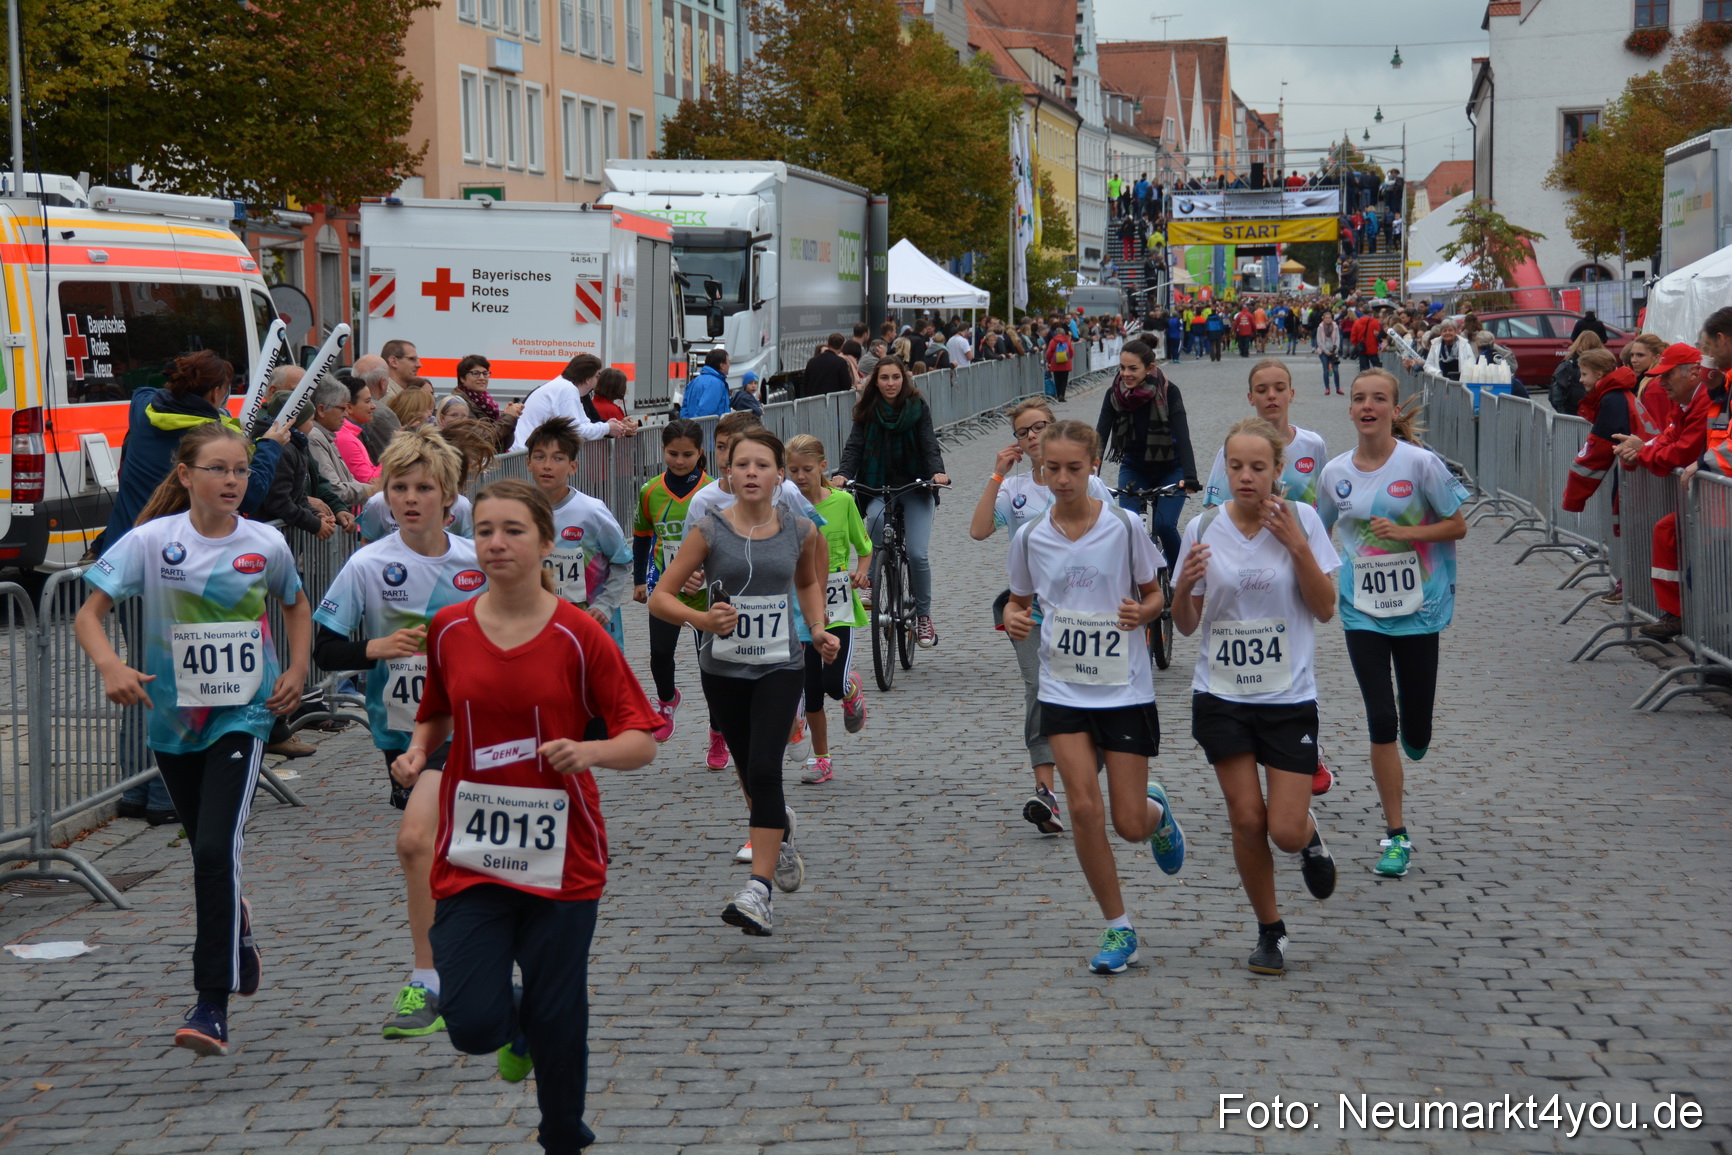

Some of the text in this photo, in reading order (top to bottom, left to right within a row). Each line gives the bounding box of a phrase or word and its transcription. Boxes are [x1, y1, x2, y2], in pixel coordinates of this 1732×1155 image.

[637, 210, 707, 226] OCK
[1223, 225, 1280, 239] START
[838, 231, 861, 280] BOCK
[472, 269, 552, 282] Bayerisches
[472, 285, 509, 297] Rotes
[893, 294, 945, 305] Laufsport
[471, 302, 509, 313] Kreuz
[87, 315, 127, 338] Bayerisches
[90, 337, 110, 355] Rotes
[512, 338, 596, 348] Katastrophenschutz
[519, 348, 556, 356] Freistaat
[93, 360, 114, 378] Kreuz
[654, 520, 685, 537] BO
[1355, 559, 1407, 570] PARTL Neumarkt
[160, 567, 186, 576] PARTL
[1361, 567, 1415, 594] 4010
[382, 590, 409, 598] PARTL
[1374, 599, 1403, 609] Louisa
[718, 612, 782, 640] 017
[1055, 616, 1075, 626] PARTL
[174, 630, 248, 641] PARTL Neumarkt
[1212, 626, 1273, 636] PARTL Neumarkt
[1057, 629, 1121, 657] 4012
[735, 645, 766, 655] Judith
[1216, 636, 1283, 666] 4034
[182, 642, 256, 675] 4016
[390, 663, 413, 671] PARTL
[1076, 663, 1098, 675] Nina
[1236, 673, 1262, 685] Anna
[199, 682, 241, 695] Marike
[492, 746, 520, 761] DEHN
[458, 791, 549, 809] PARTL Neumarkt
[465, 808, 556, 850] 4013
[483, 854, 529, 871] Selina
